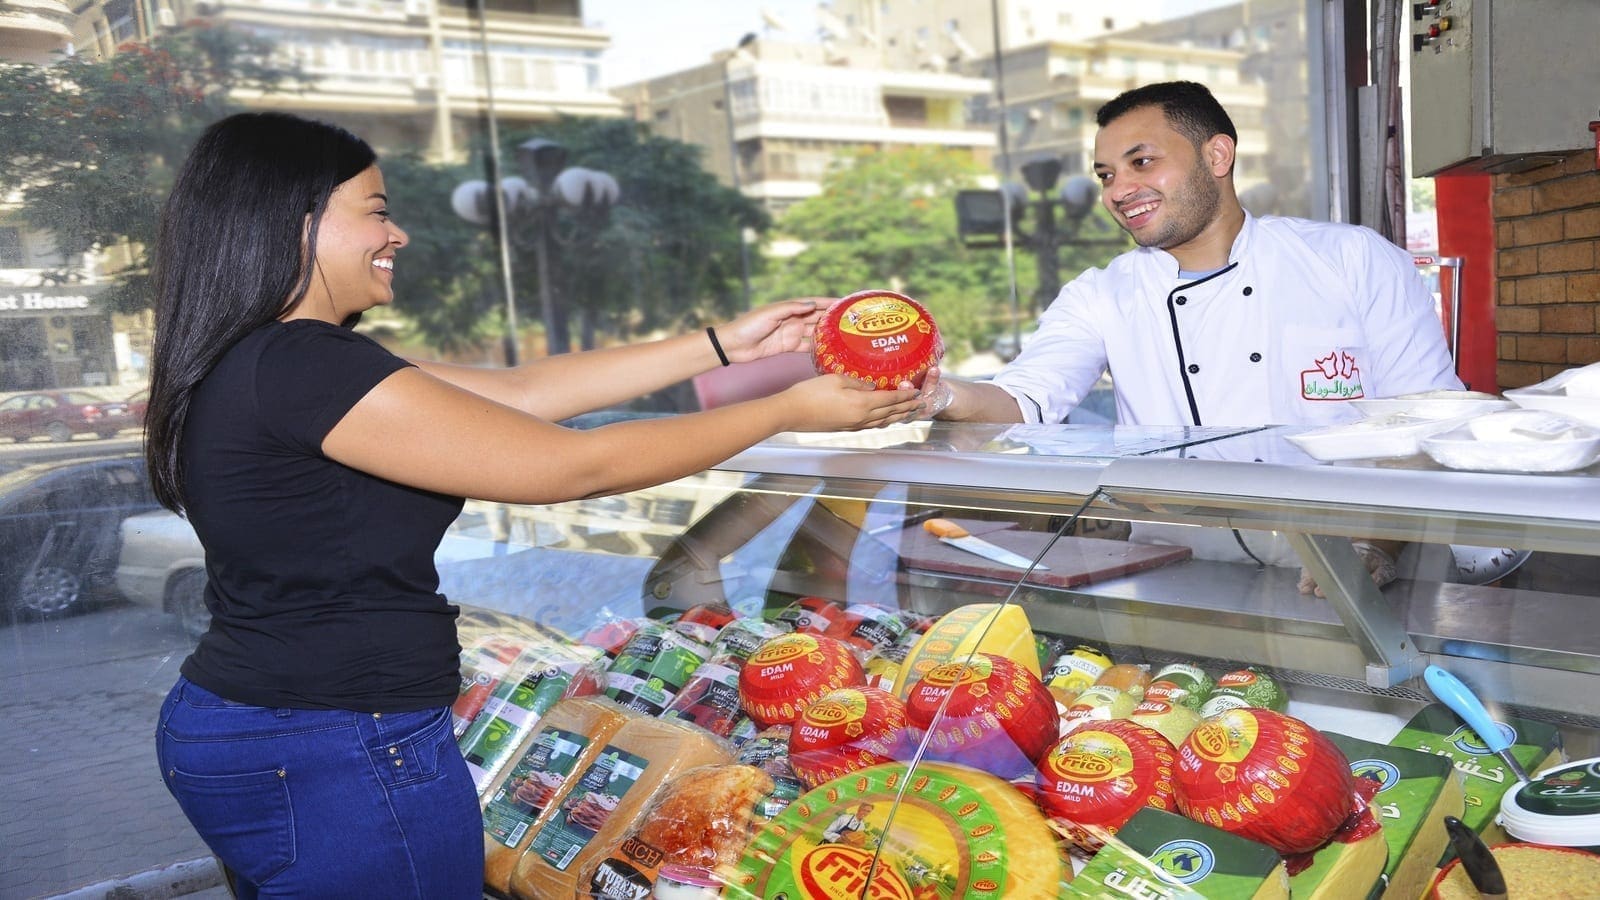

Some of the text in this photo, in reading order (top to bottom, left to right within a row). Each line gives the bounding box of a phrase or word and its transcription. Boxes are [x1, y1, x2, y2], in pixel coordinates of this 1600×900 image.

[22, 292, 89, 310] Home
[861, 316, 904, 329] Frico
[871, 334, 908, 349] EDAM
[760, 646, 797, 660] Frico
[761, 663, 793, 677] EDAM
[920, 686, 949, 697] EDAM
[810, 705, 842, 718] Frico
[800, 726, 830, 740] EDAM
[1200, 727, 1221, 751] Frico
[1062, 755, 1106, 771] Frico
[1181, 745, 1202, 773] EDAM
[1056, 781, 1095, 797] EDAM
[1063, 794, 1081, 802] MILD
[624, 838, 661, 867] RICH
[816, 852, 903, 900] Fric
